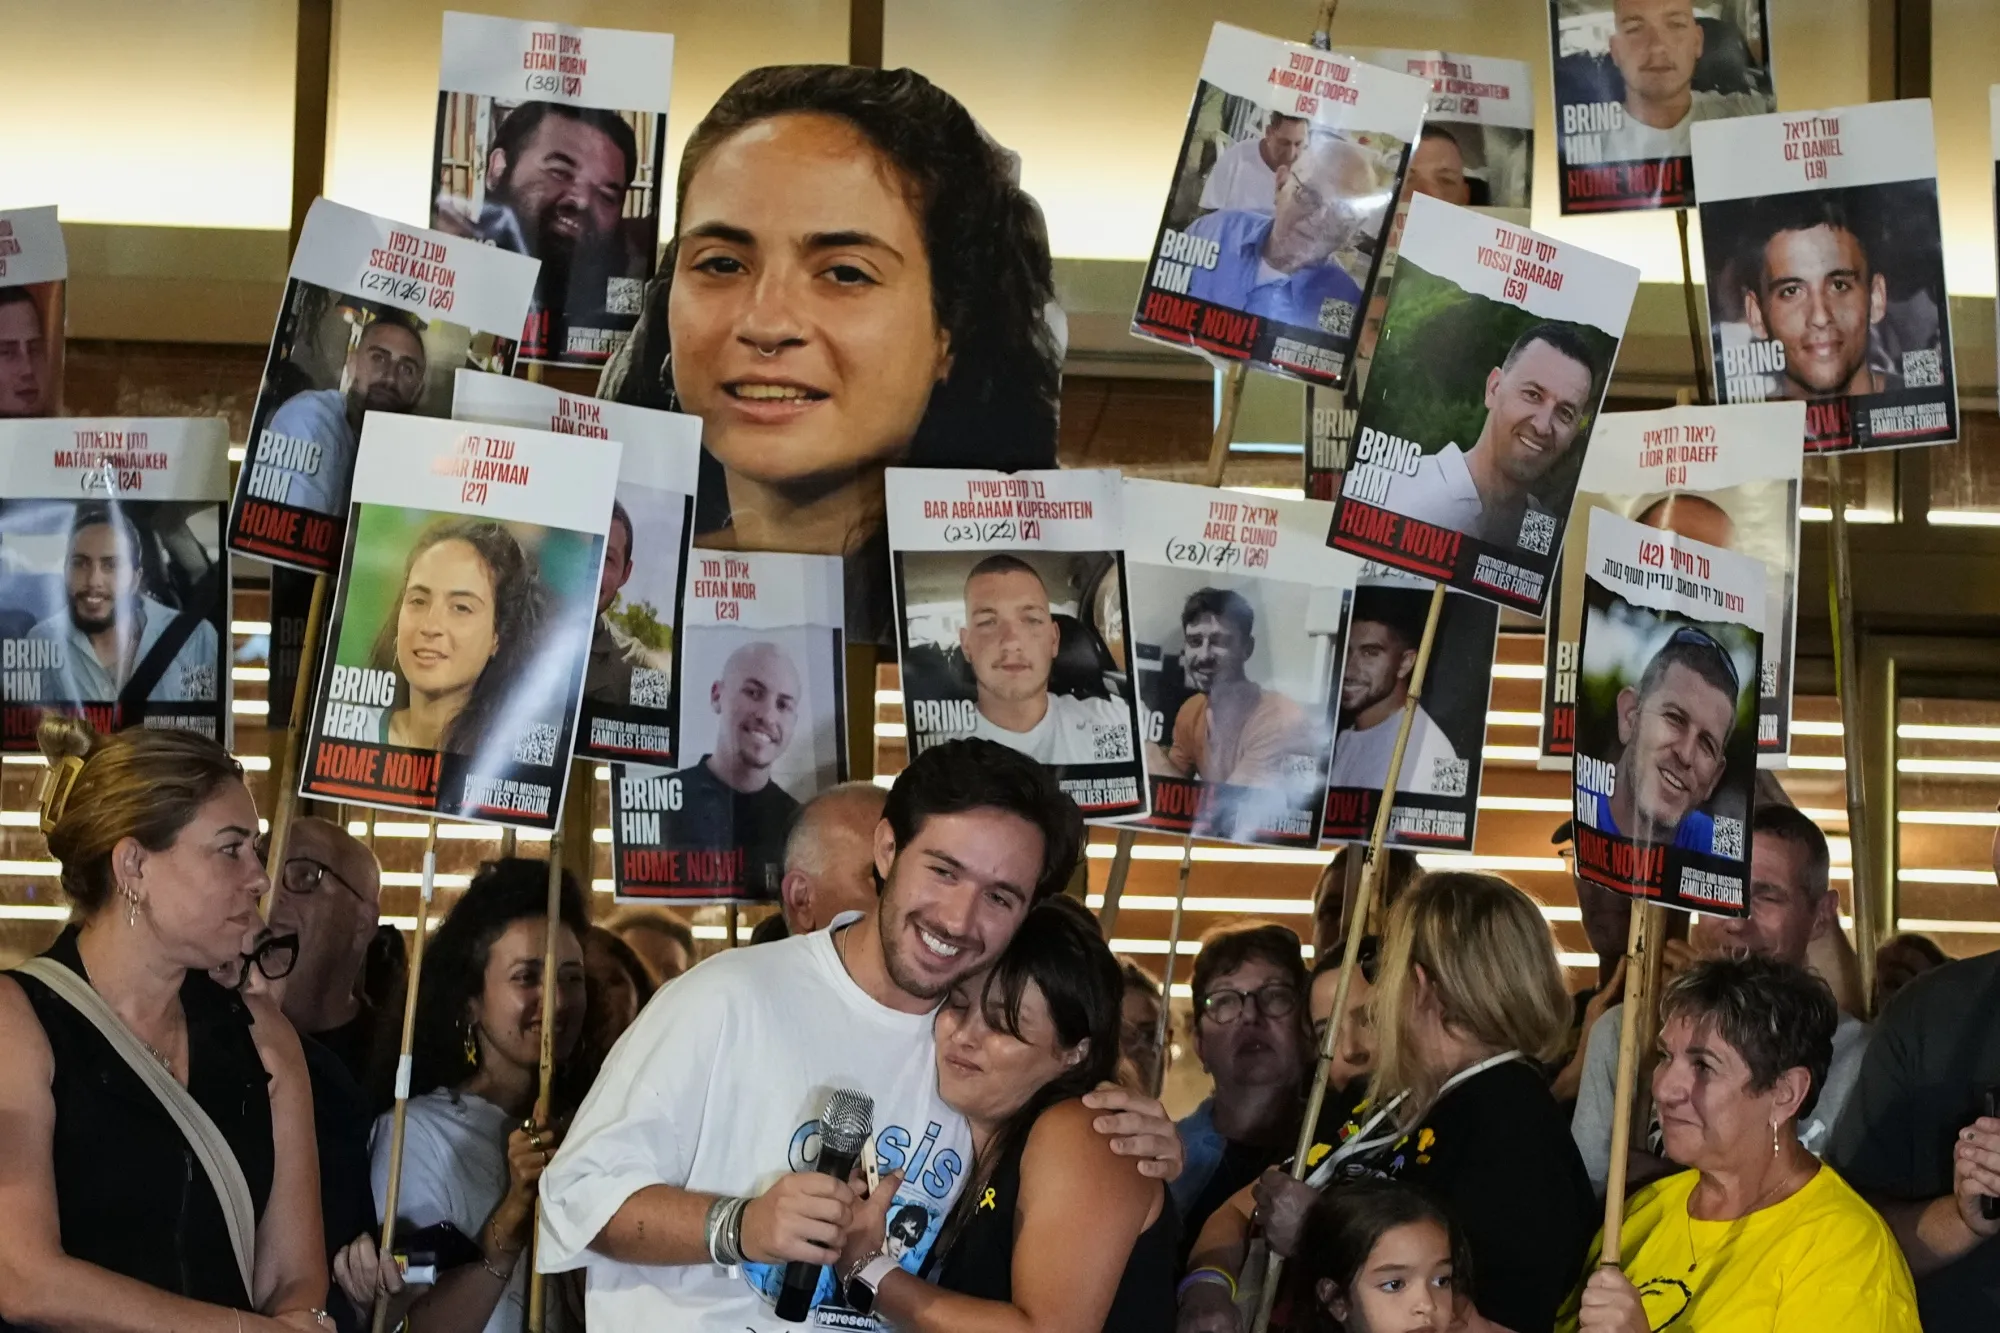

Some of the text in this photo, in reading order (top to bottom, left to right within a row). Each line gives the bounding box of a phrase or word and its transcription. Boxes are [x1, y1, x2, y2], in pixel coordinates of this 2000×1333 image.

[532, 32, 556, 51] הורן
[523, 52, 587, 75] EITAN HORN
[1290, 52, 1350, 82] עמירם קופר
[525, 73, 560, 94] (38)
[1268, 67, 1359, 106] AMIRAM COOPER
[1295, 94, 1319, 116] (85)
[1563, 101, 1622, 134] BRING
[1565, 133, 1602, 165] HIM
[1784, 138, 1844, 161] OZ DANIEL
[1567, 158, 1683, 197] HOME NOW!
[1804, 158, 1827, 181] (19)
[388, 230, 420, 256] כלפון
[420, 240, 447, 264] שגב
[1159, 228, 1220, 270] BRING
[1495, 227, 1557, 264] יוסי שרעבי
[369, 248, 456, 288] SEGEV KALFON
[1151, 258, 1193, 295] HIM
[1477, 245, 1564, 292] YOSSI SHARABI
[1503, 277, 1528, 304] (53)
[1143, 292, 1258, 348] HOME NOW!
[1722, 340, 1786, 377] BRING
[1726, 375, 1766, 405] HIM
[551, 415, 575, 435] ITAY
[558, 397, 601, 424] איתי חן
[1312, 408, 1358, 438] BRIN
[1806, 399, 1850, 436] OW!
[1870, 412, 1948, 435] FAMILIES FORUM
[1903, 405, 1917, 416] AND
[255, 428, 322, 476] BRING
[485, 438, 516, 460] ענבר
[1356, 426, 1422, 477] BRING
[1643, 425, 1716, 449] ליאור רודאיף
[54, 450, 95, 469] MATAN
[1639, 446, 1719, 468] LIOR RUDAEFF
[247, 462, 292, 504] HIM
[471, 459, 530, 486] HAYMAN
[1350, 461, 1392, 506] HIM
[1665, 465, 1687, 487] (61)
[461, 480, 488, 505] (27)
[967, 479, 1045, 500] בר קופרשטיין
[238, 501, 301, 544] HOME
[924, 500, 1093, 519] BAR ABRAHAM KUPERSHTEIN
[1209, 501, 1279, 527] אריאל קוניו
[1203, 521, 1278, 548] ARIEL CUNIO
[1339, 500, 1463, 566] HOME NOW!
[700, 559, 750, 580] איתן מור
[1478, 553, 1545, 585] HOSTAGES AND MISSING
[1638, 539, 1710, 580] טל חיימי (42)
[694, 580, 756, 600] EITAN MOR
[1473, 564, 1541, 602] FAMILIES FORUM
[1602, 558, 1744, 613] נרצח על ידי חמאס. עדיין חטוף בעזה.
[715, 600, 739, 621] (23)
[3, 671, 41, 702] HIM
[328, 664, 397, 708] BRING
[321, 700, 368, 742] HER
[591, 716, 670, 738] HOSTAGES AND MISSING
[913, 698, 977, 733] BRING
[590, 728, 670, 753] FAMILIES FORUM
[315, 742, 381, 784] HOME
[381, 750, 442, 793] NOW!
[1576, 751, 1616, 798] BRING
[502, 779, 519, 795] AND
[519, 781, 552, 799] MISSING
[619, 776, 683, 811] BRING
[1103, 787, 1139, 805] FORUM
[1155, 781, 1216, 816] NOW!
[511, 794, 551, 815] FORUM
[1327, 790, 1371, 824] OW!
[1576, 787, 1598, 829] HIM
[621, 811, 661, 845] HIM
[1389, 816, 1465, 838] FAMILIES FORUM
[622, 850, 681, 882] HOME
[686, 847, 745, 883] NOW!
[1578, 827, 1665, 884] HOME NOW!
[1679, 877, 1744, 906] FAMILIES FORUM
[1705, 872, 1718, 885] AND
[788, 1119, 962, 1199] osis
